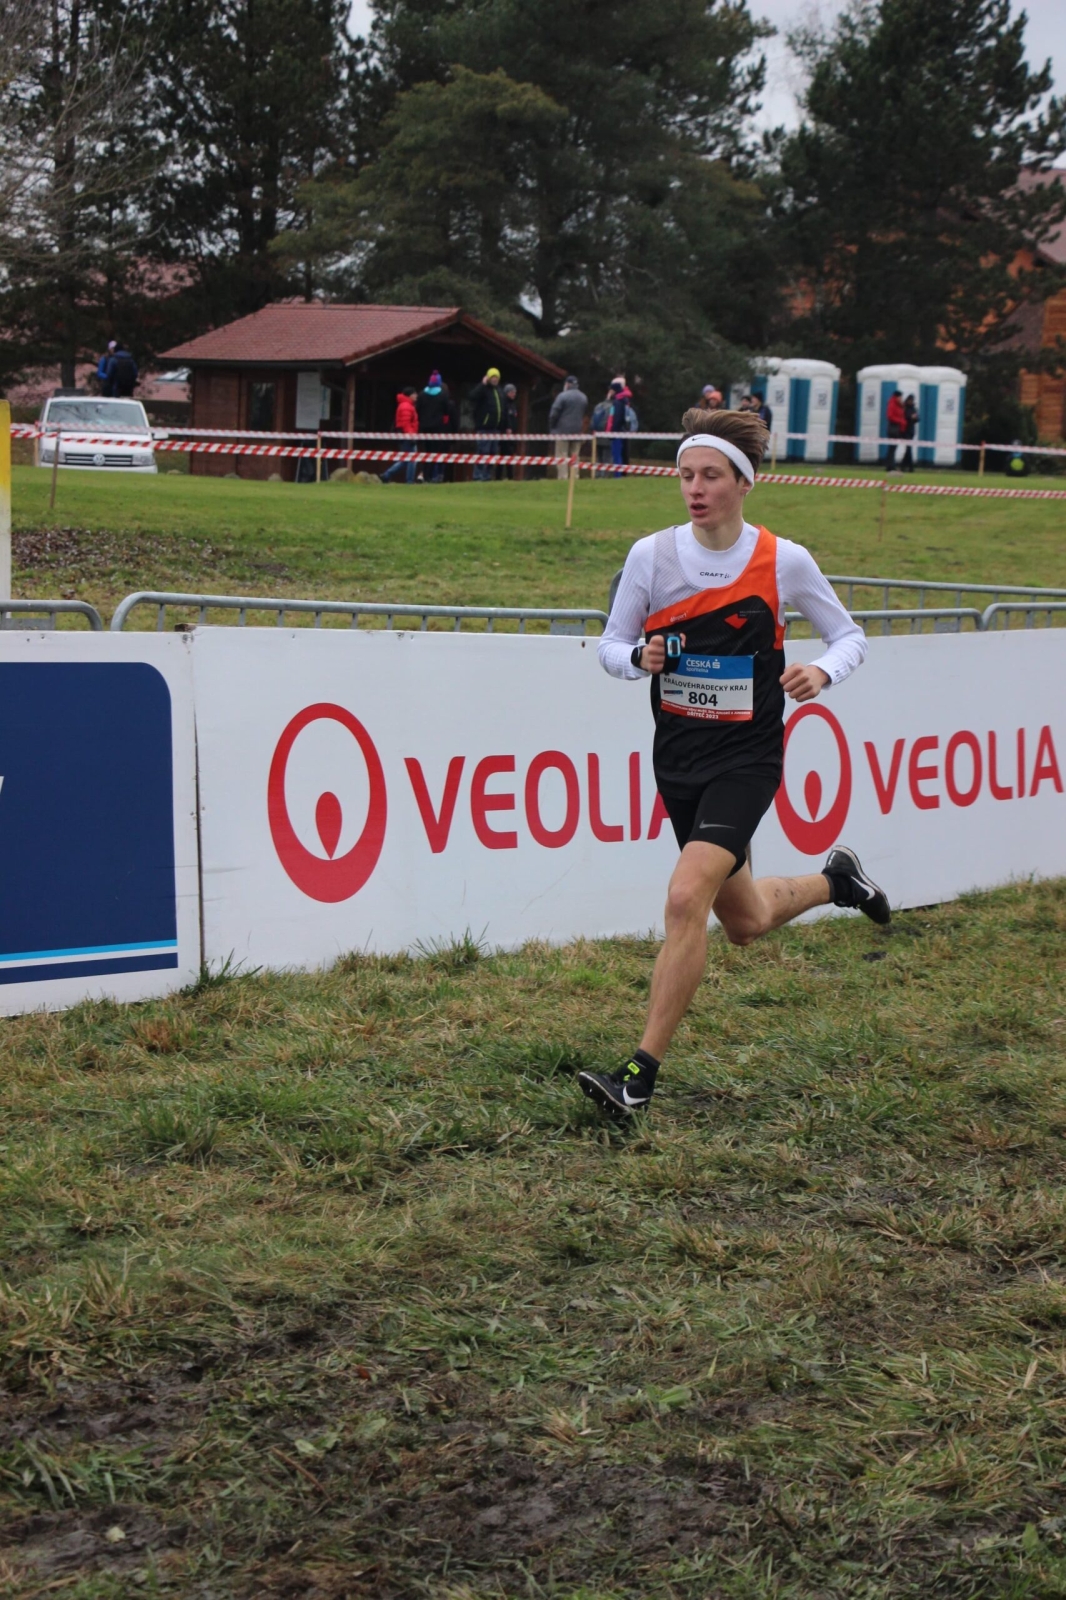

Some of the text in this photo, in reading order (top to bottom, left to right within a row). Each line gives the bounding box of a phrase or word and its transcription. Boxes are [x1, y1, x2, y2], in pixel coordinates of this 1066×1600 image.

[686, 658, 711, 668] ČESKÁ
[663, 677, 748, 692] KRÁLOVÉHRADECKÝ KRAJ
[688, 691, 718, 707] 804
[863, 725, 1065, 815] VEOLIA
